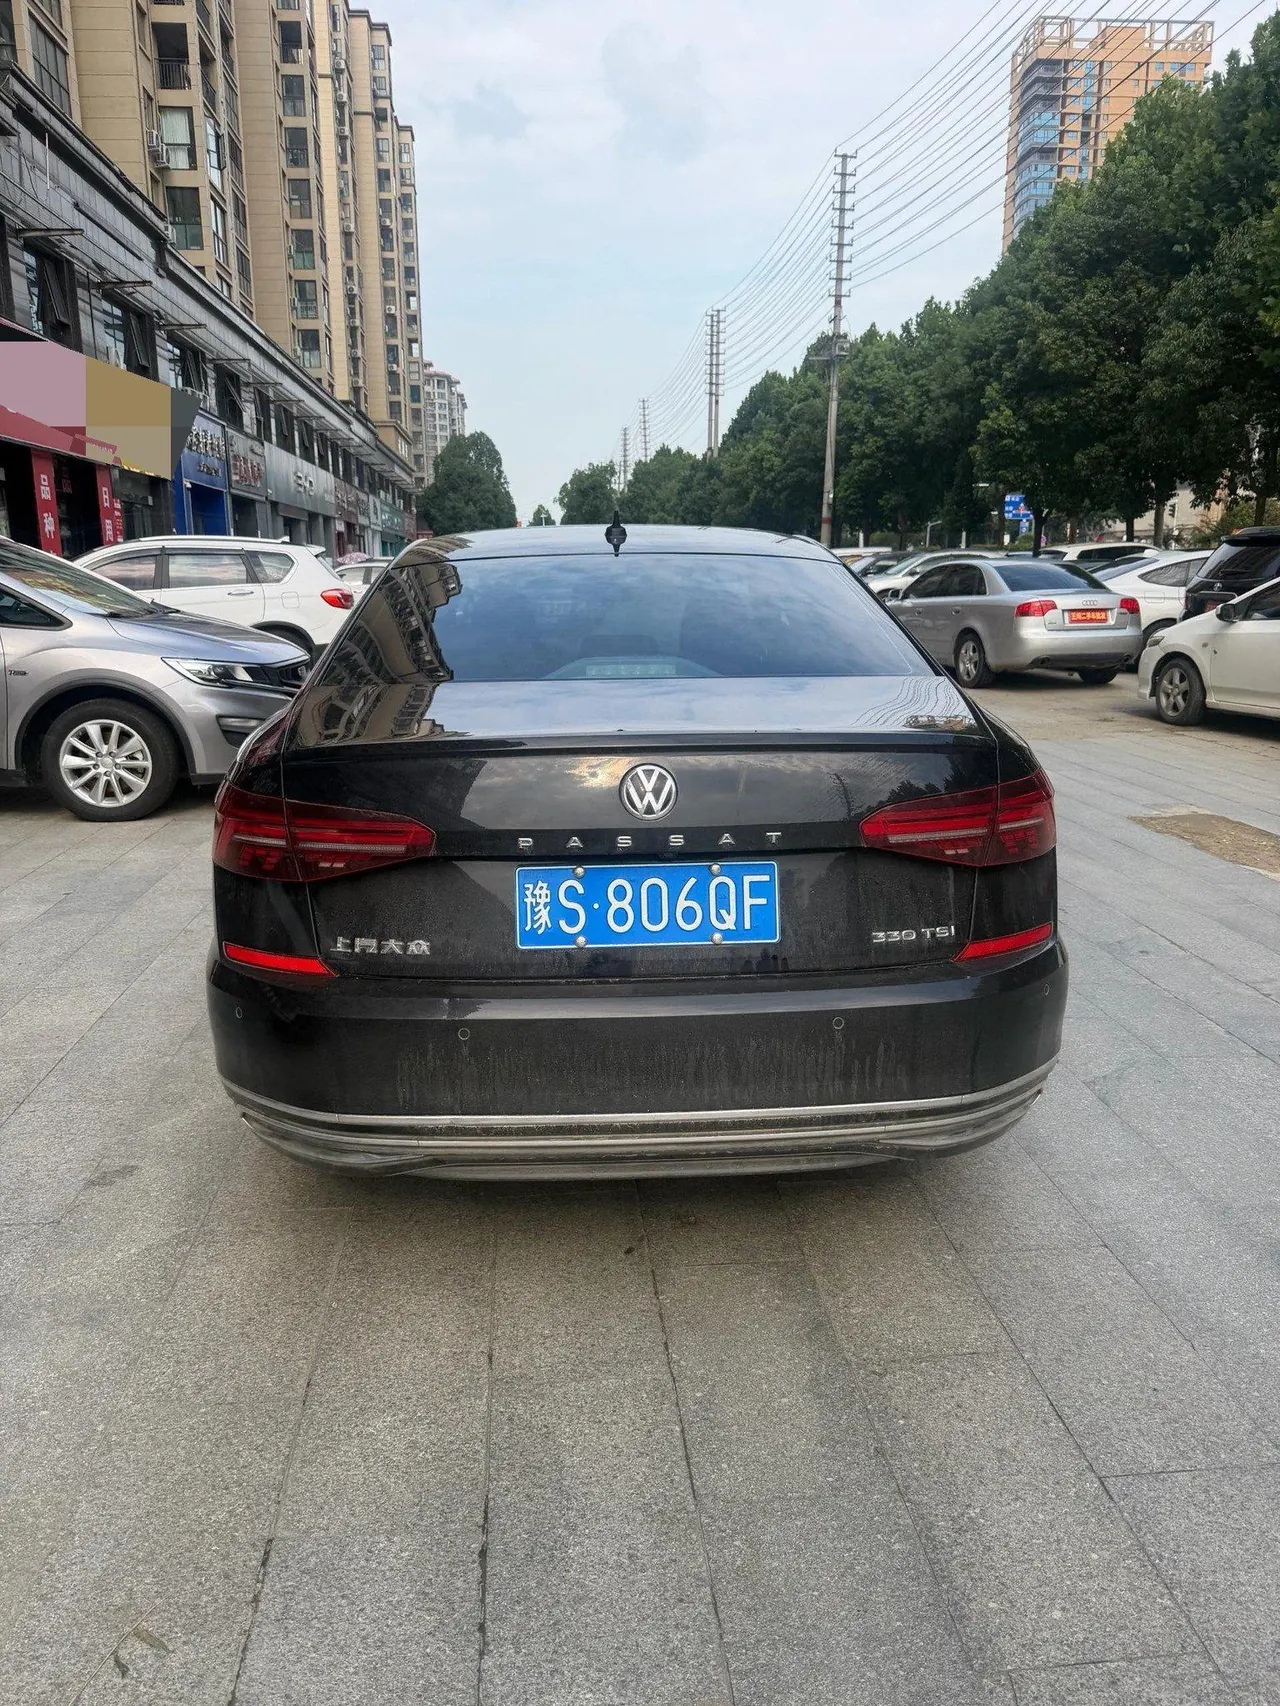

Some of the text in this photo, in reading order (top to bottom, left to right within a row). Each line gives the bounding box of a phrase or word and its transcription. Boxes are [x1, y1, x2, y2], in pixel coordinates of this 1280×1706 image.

[517, 832, 782, 849] PASSAT
[524, 874, 771, 935] 豫S·806QF
[872, 925, 955, 942] 330 TSI
[329, 936, 430, 955] 上汽大众
